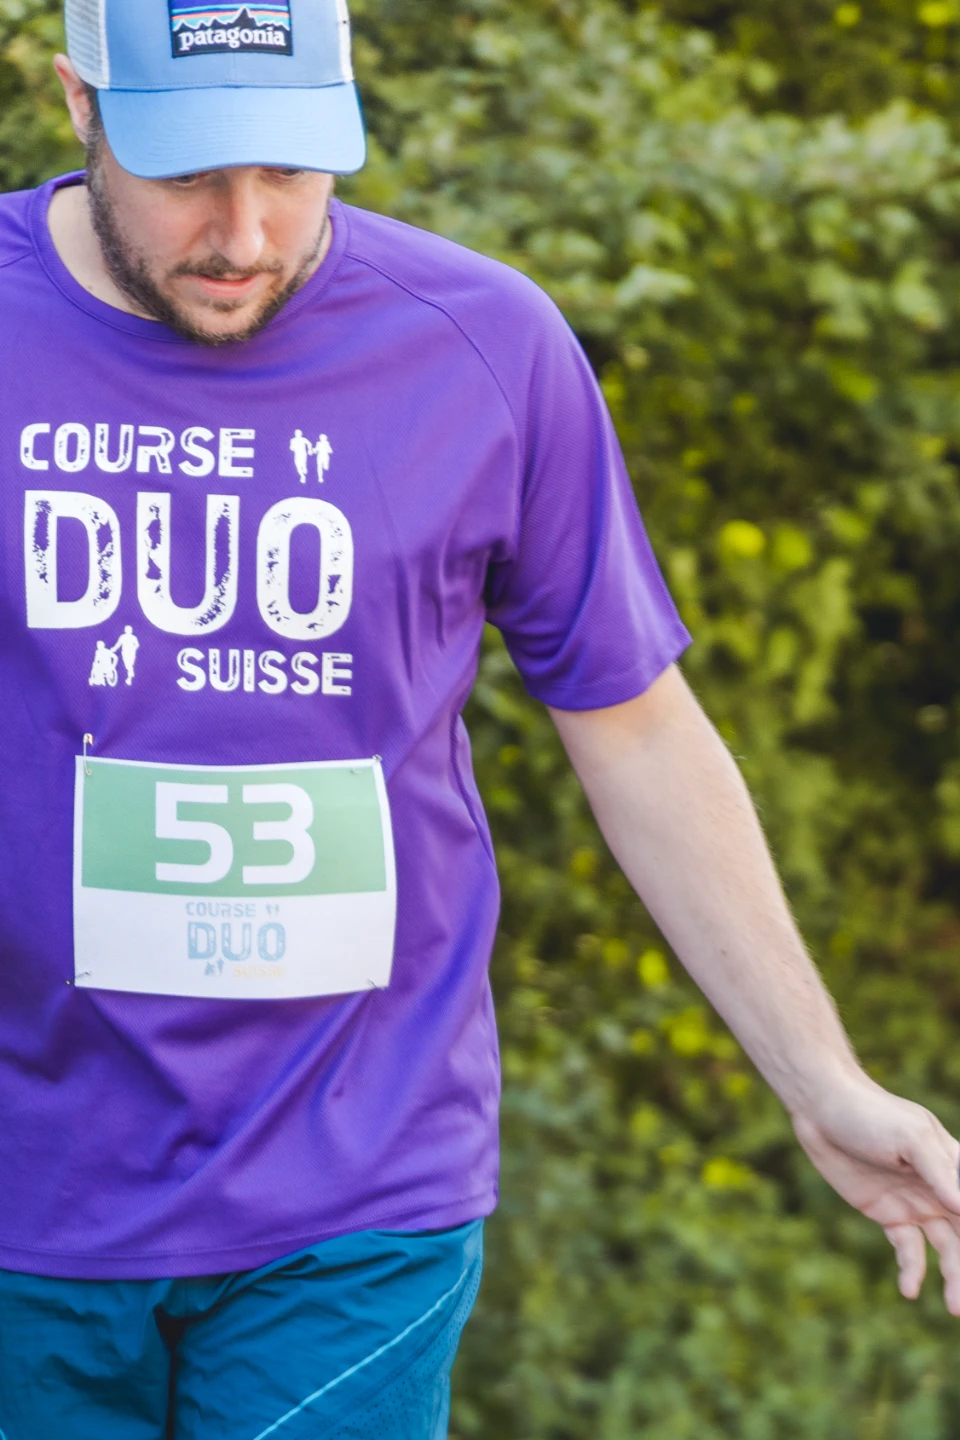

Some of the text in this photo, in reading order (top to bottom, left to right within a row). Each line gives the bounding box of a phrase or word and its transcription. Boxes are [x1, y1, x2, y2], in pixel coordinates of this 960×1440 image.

[178, 26, 287, 51] patagonia
[20, 422, 256, 477] COURSE
[24, 490, 354, 641] DUO
[176, 647, 353, 696] SUISSE
[155, 781, 316, 884] 53
[186, 901, 256, 917] COURSE
[187, 921, 286, 961] DUO
